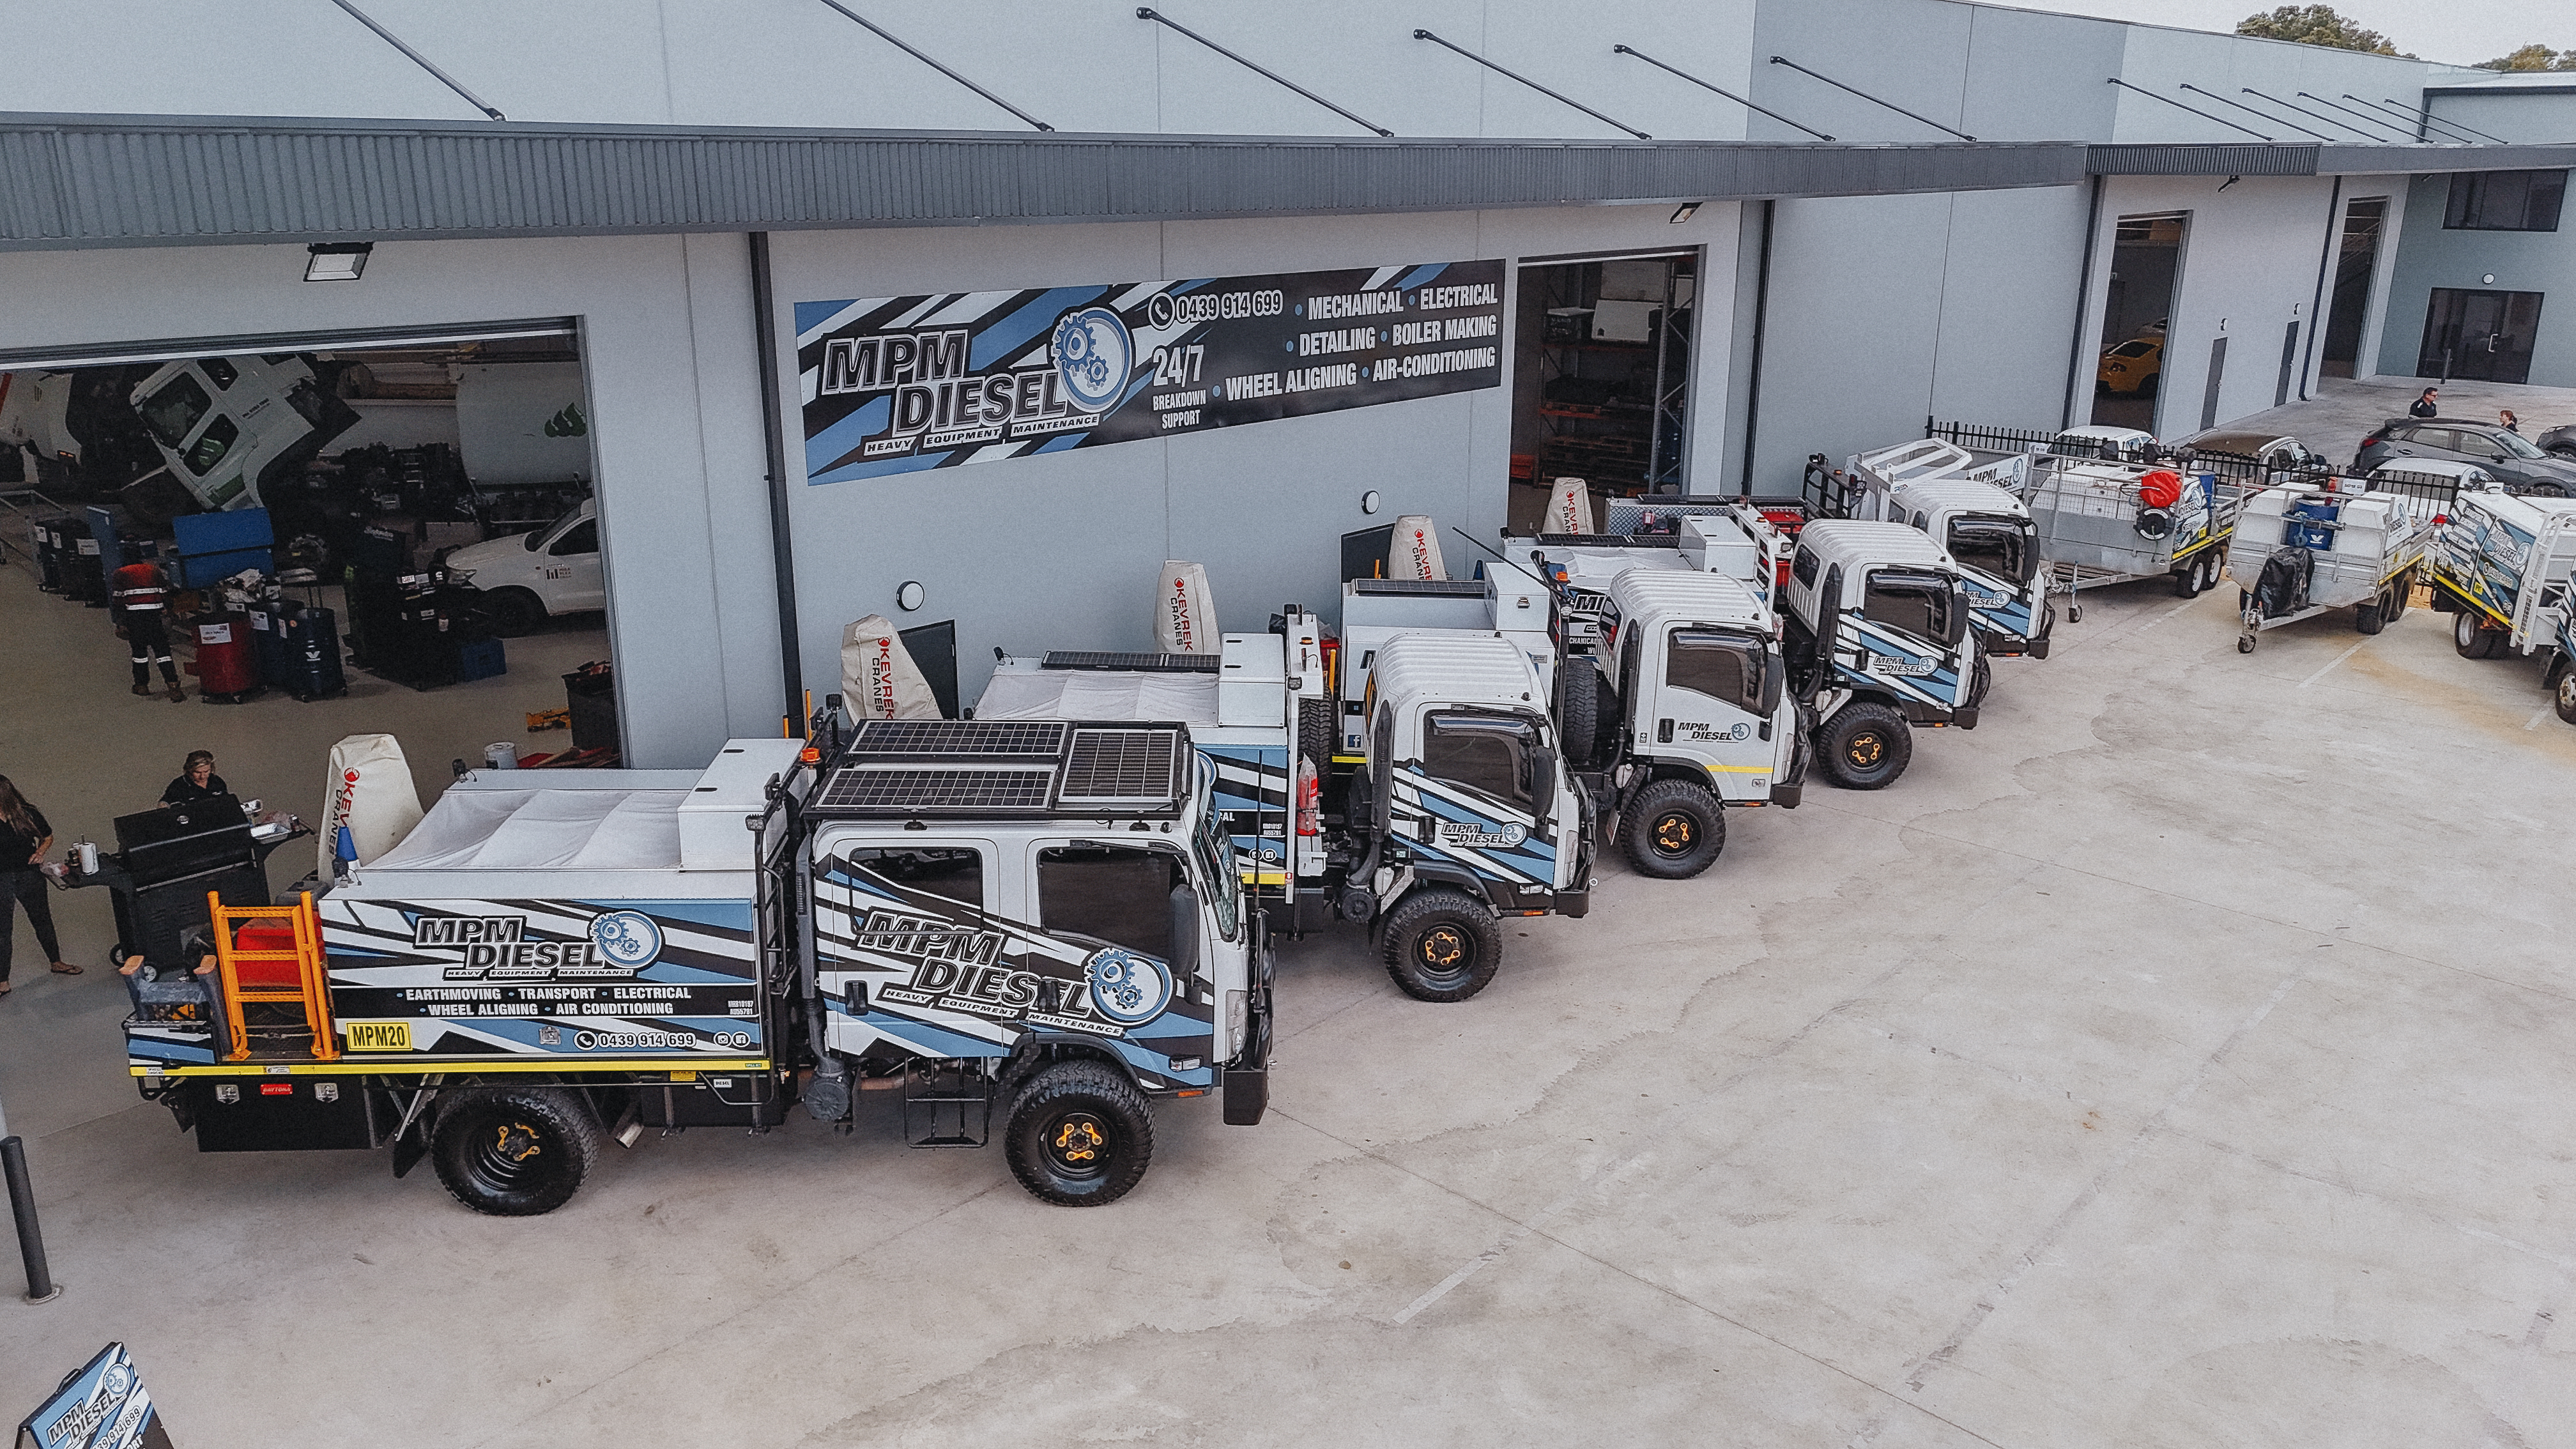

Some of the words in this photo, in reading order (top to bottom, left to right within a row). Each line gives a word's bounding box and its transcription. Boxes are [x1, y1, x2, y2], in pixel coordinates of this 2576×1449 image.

[1177, 295, 1218, 321] 0439
[1222, 291, 1250, 318] 914
[1252, 289, 1283, 316] 699
[1308, 291, 1404, 320] MECHANICAL
[1420, 283, 1498, 310] ELECTRICAL
[1300, 327, 1375, 356] DETAILING
[1392, 321, 1441, 346] BOILER
[1445, 315, 1496, 341] MAKING
[823, 330, 967, 394] MPM
[1153, 345, 1204, 387] 24/7
[1226, 372, 1282, 401] WHEEL
[1285, 363, 1356, 393] ALIGNING
[1372, 346, 1495, 382] AIR-CONDITIONING
[893, 369, 1068, 437] DIESEL
[1153, 389, 1206, 411] BREAKDOWN
[868, 439, 912, 452] HEAVY
[926, 429, 1000, 445] EQUIPMENT
[1013, 417, 1098, 434] MAINTENANCE
[1162, 409, 1200, 429] SUPPORT
[1170, 597, 1183, 646] CRANES
[1177, 588, 1193, 652] KEVREK
[872, 657, 884, 712] CRANES
[880, 648, 894, 720] KEVREK
[1677, 723, 1710, 731] MPM
[1691, 732, 1732, 741] DIESEL
[328, 789, 343, 857] CRANES
[1442, 824, 1481, 834] MPM
[1459, 834, 1506, 844] DIESEL
[416, 917, 525, 947] MPM
[857, 910, 1004, 967] MPM
[466, 942, 606, 969] DIESEL
[406, 989, 501, 1001] EARTHMOVING
[518, 988, 596, 1000] TRANSPORT
[614, 987, 691, 999] ELECTRICAL
[427, 1004, 475, 1016] WHEEL
[478, 1004, 538, 1016] ALIGNING
[556, 1004, 578, 1015] AIR
[581, 1003, 673, 1015] CONDITIONING
[885, 991, 928, 1003] HEAVY
[941, 999, 1016, 1016] EQUIPMENT
[1029, 1013, 1121, 1034] MAINTENANCE
[352, 1025, 406, 1046] MPM20
[598, 1033, 636, 1047] 0439
[638, 1033, 665, 1046] 914
[667, 1032, 696, 1046] 699
[49, 1400, 85, 1443] MPM
[70, 1392, 117, 1440] DIESEL
[125, 1407, 141, 1427] 699
